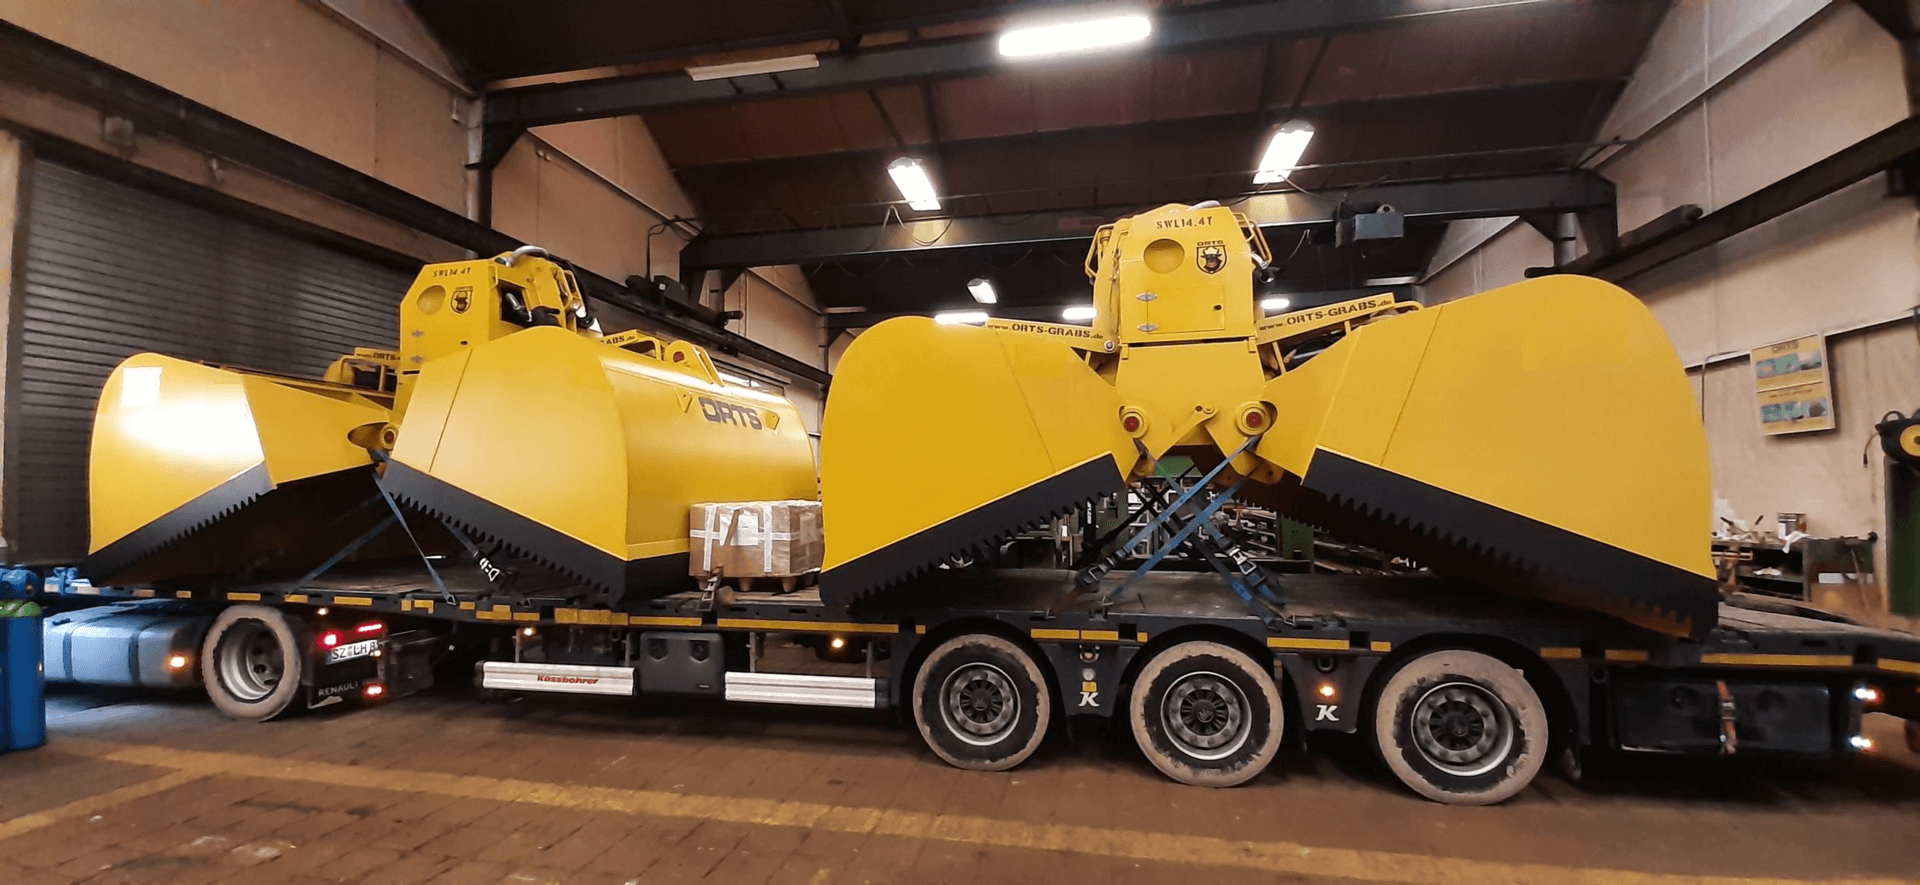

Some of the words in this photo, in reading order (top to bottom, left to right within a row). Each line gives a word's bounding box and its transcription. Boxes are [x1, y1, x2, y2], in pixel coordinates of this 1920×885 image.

[1156, 216, 1212, 229] SWL14.4T
[1259, 300, 1392, 331] www.ORTS-GRABS.de
[987, 323, 1104, 339] www.ORTS-GRABS.de
[698, 396, 763, 430] ORTS
[332, 647, 347, 660] SZ
[318, 681, 359, 697] RENAULT
[1078, 691, 1100, 707] K
[1315, 704, 1340, 721] K
